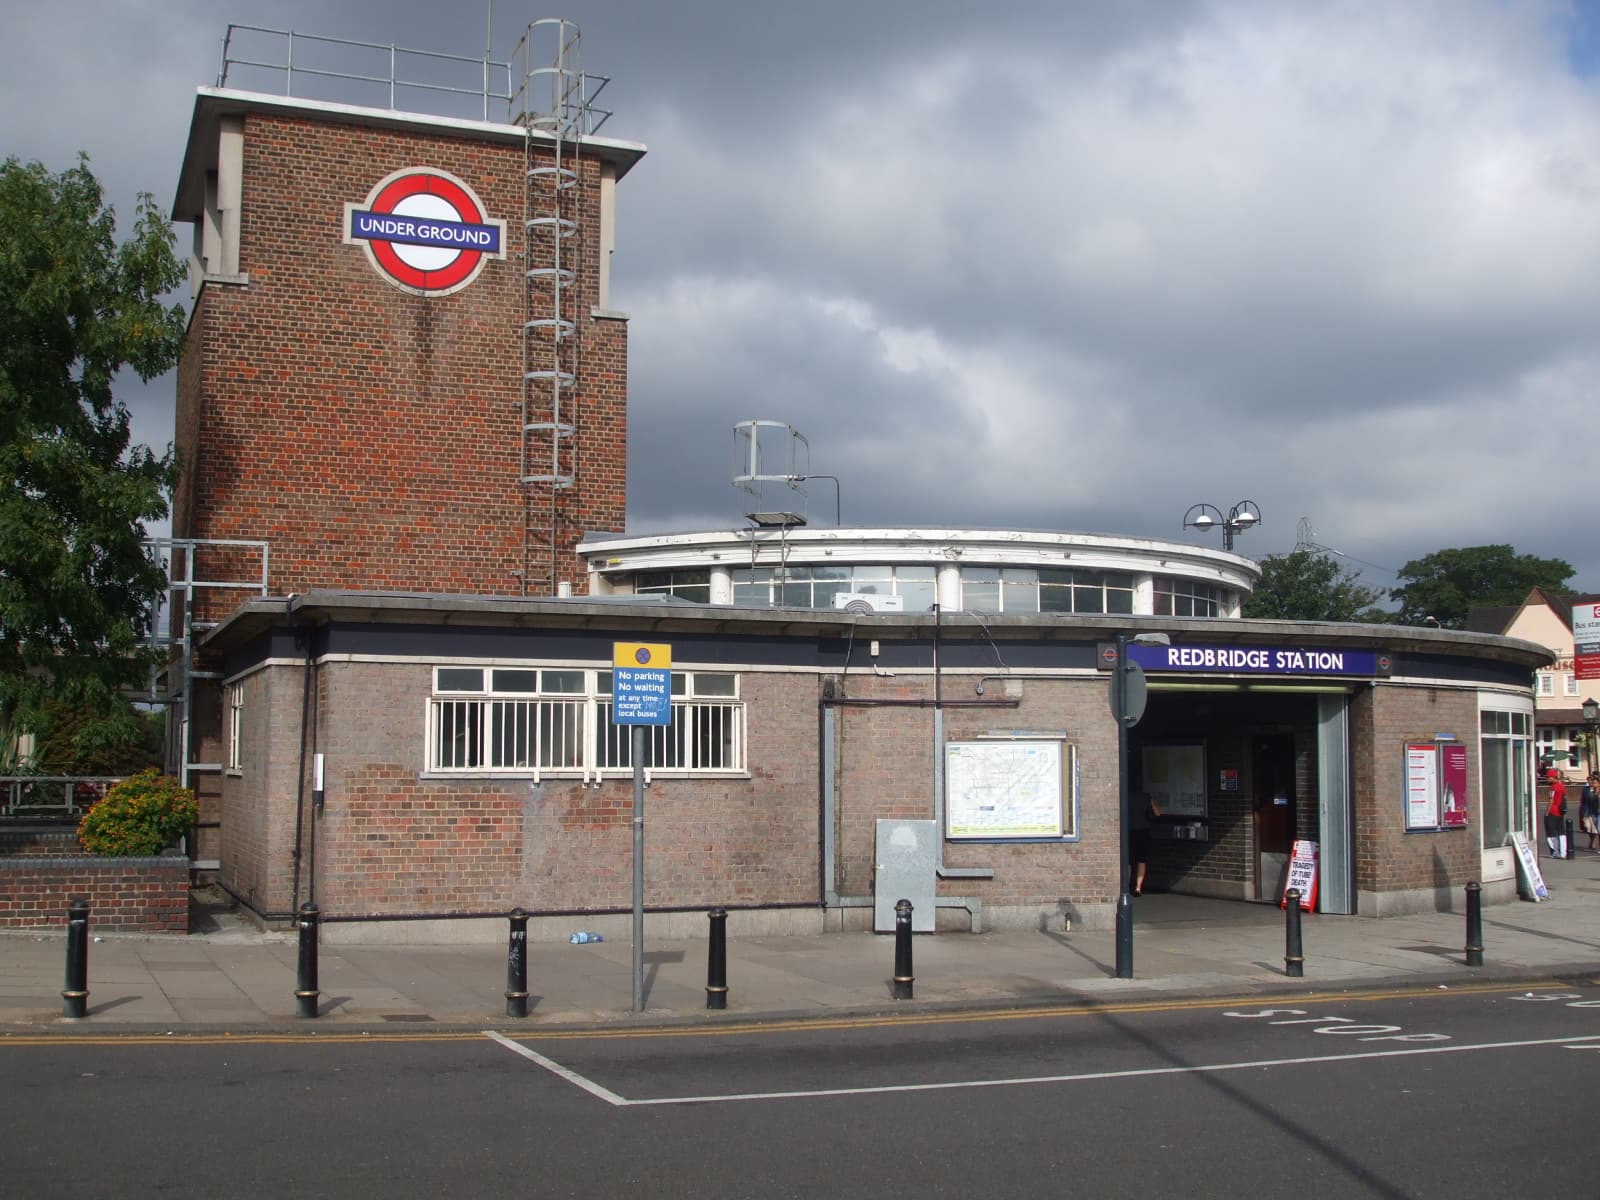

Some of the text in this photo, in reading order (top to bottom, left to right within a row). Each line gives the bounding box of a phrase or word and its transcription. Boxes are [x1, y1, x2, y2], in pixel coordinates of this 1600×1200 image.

[360, 217, 491, 245] UNDERGROUND
[1168, 648, 1344, 670] REDBRIDGE STATION
[619, 672, 665, 682] No parking
[619, 682, 664, 693] No waiting
[1222, 1009, 1452, 1042] STOP
